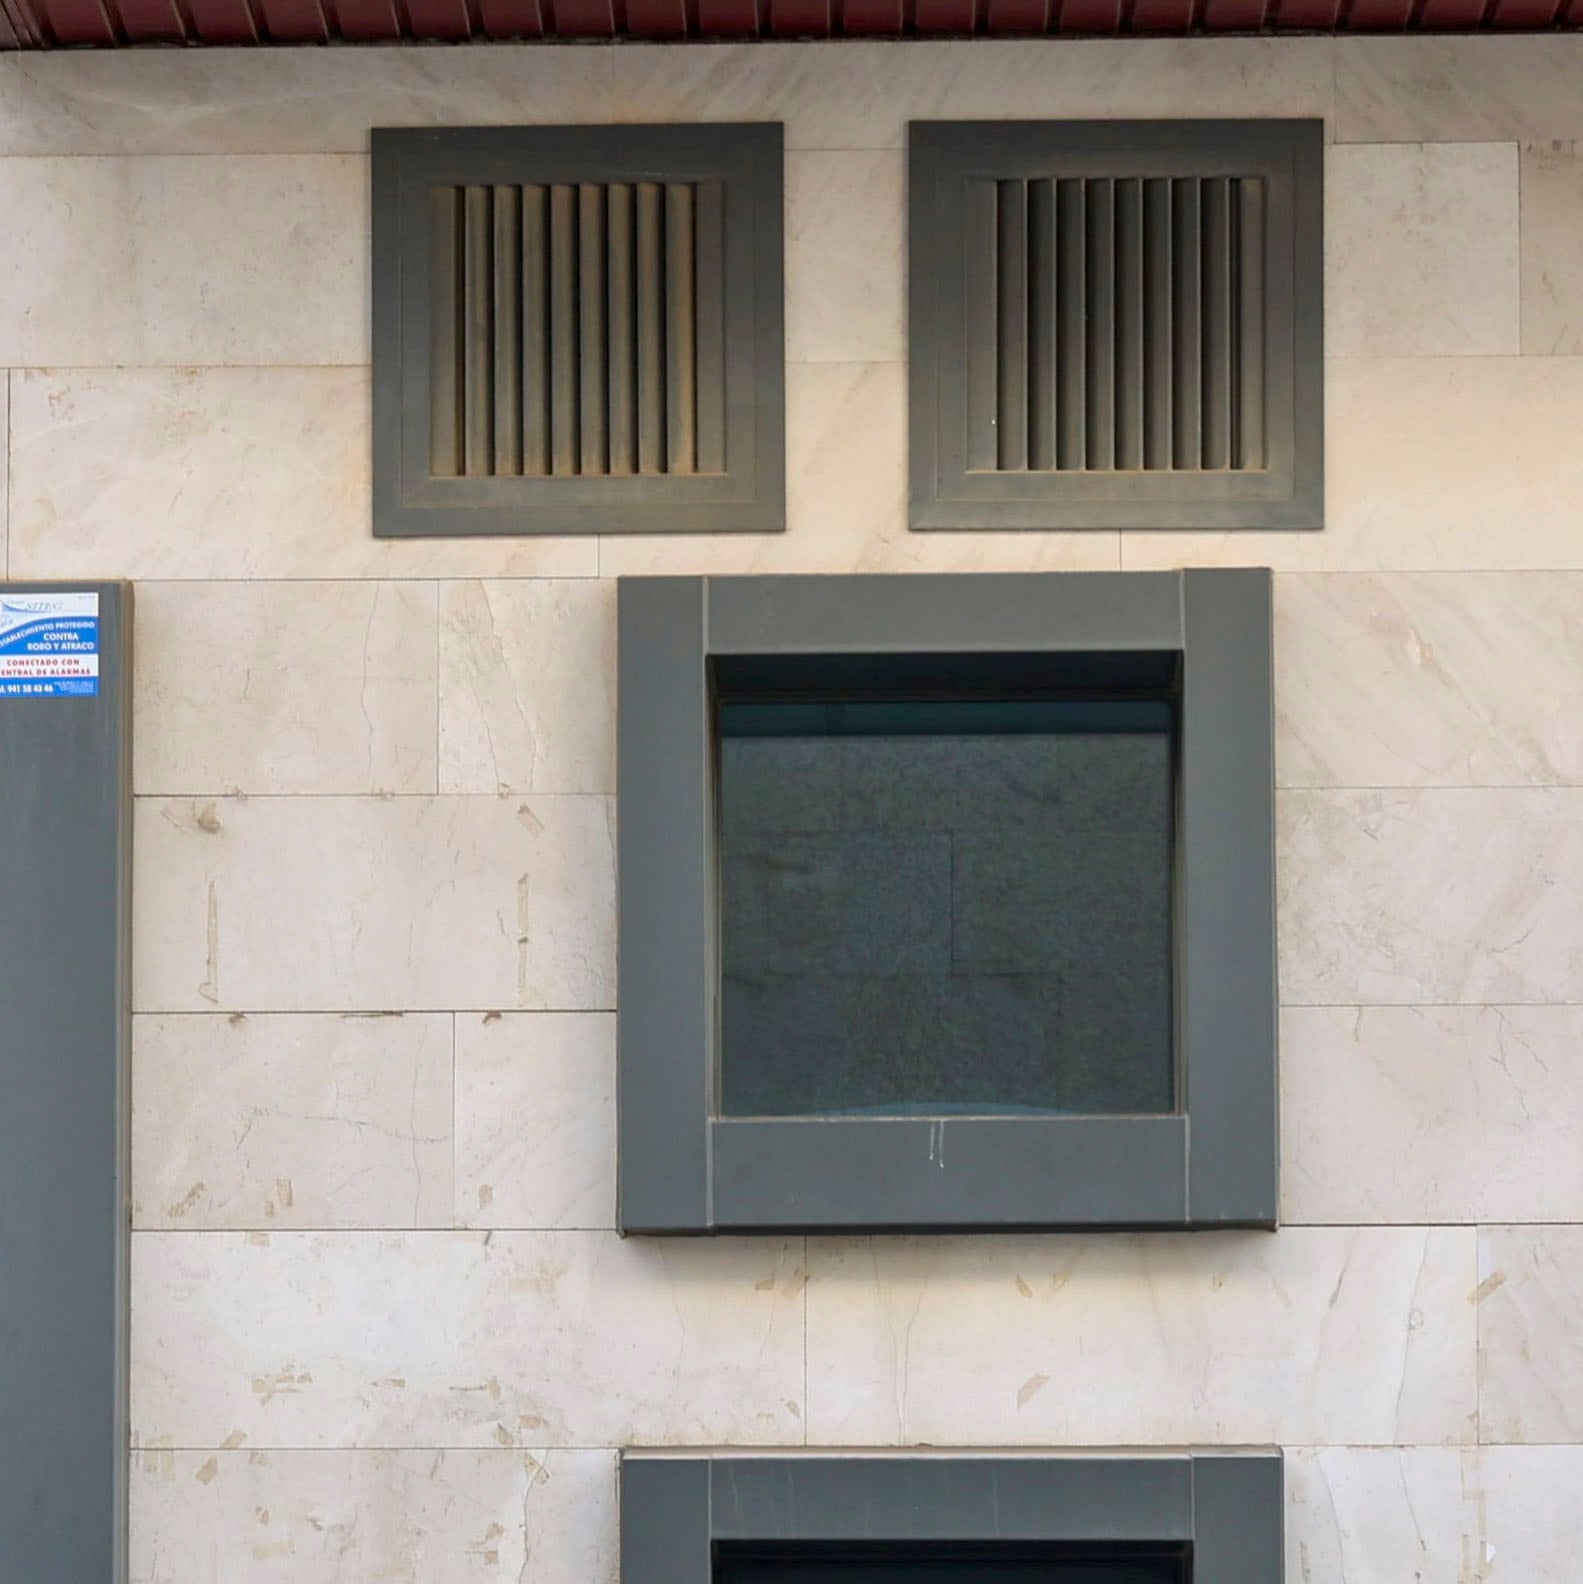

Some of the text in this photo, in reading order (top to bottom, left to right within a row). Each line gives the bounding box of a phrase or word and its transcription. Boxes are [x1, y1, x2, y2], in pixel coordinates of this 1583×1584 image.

[56, 621, 95, 630] PROTEGIDO
[43, 632, 79, 641] CONTRA
[27, 641, 94, 651] ROBO Y ATRACO
[6, 658, 58, 666] CONECTADO
[36, 668, 47, 676] DE
